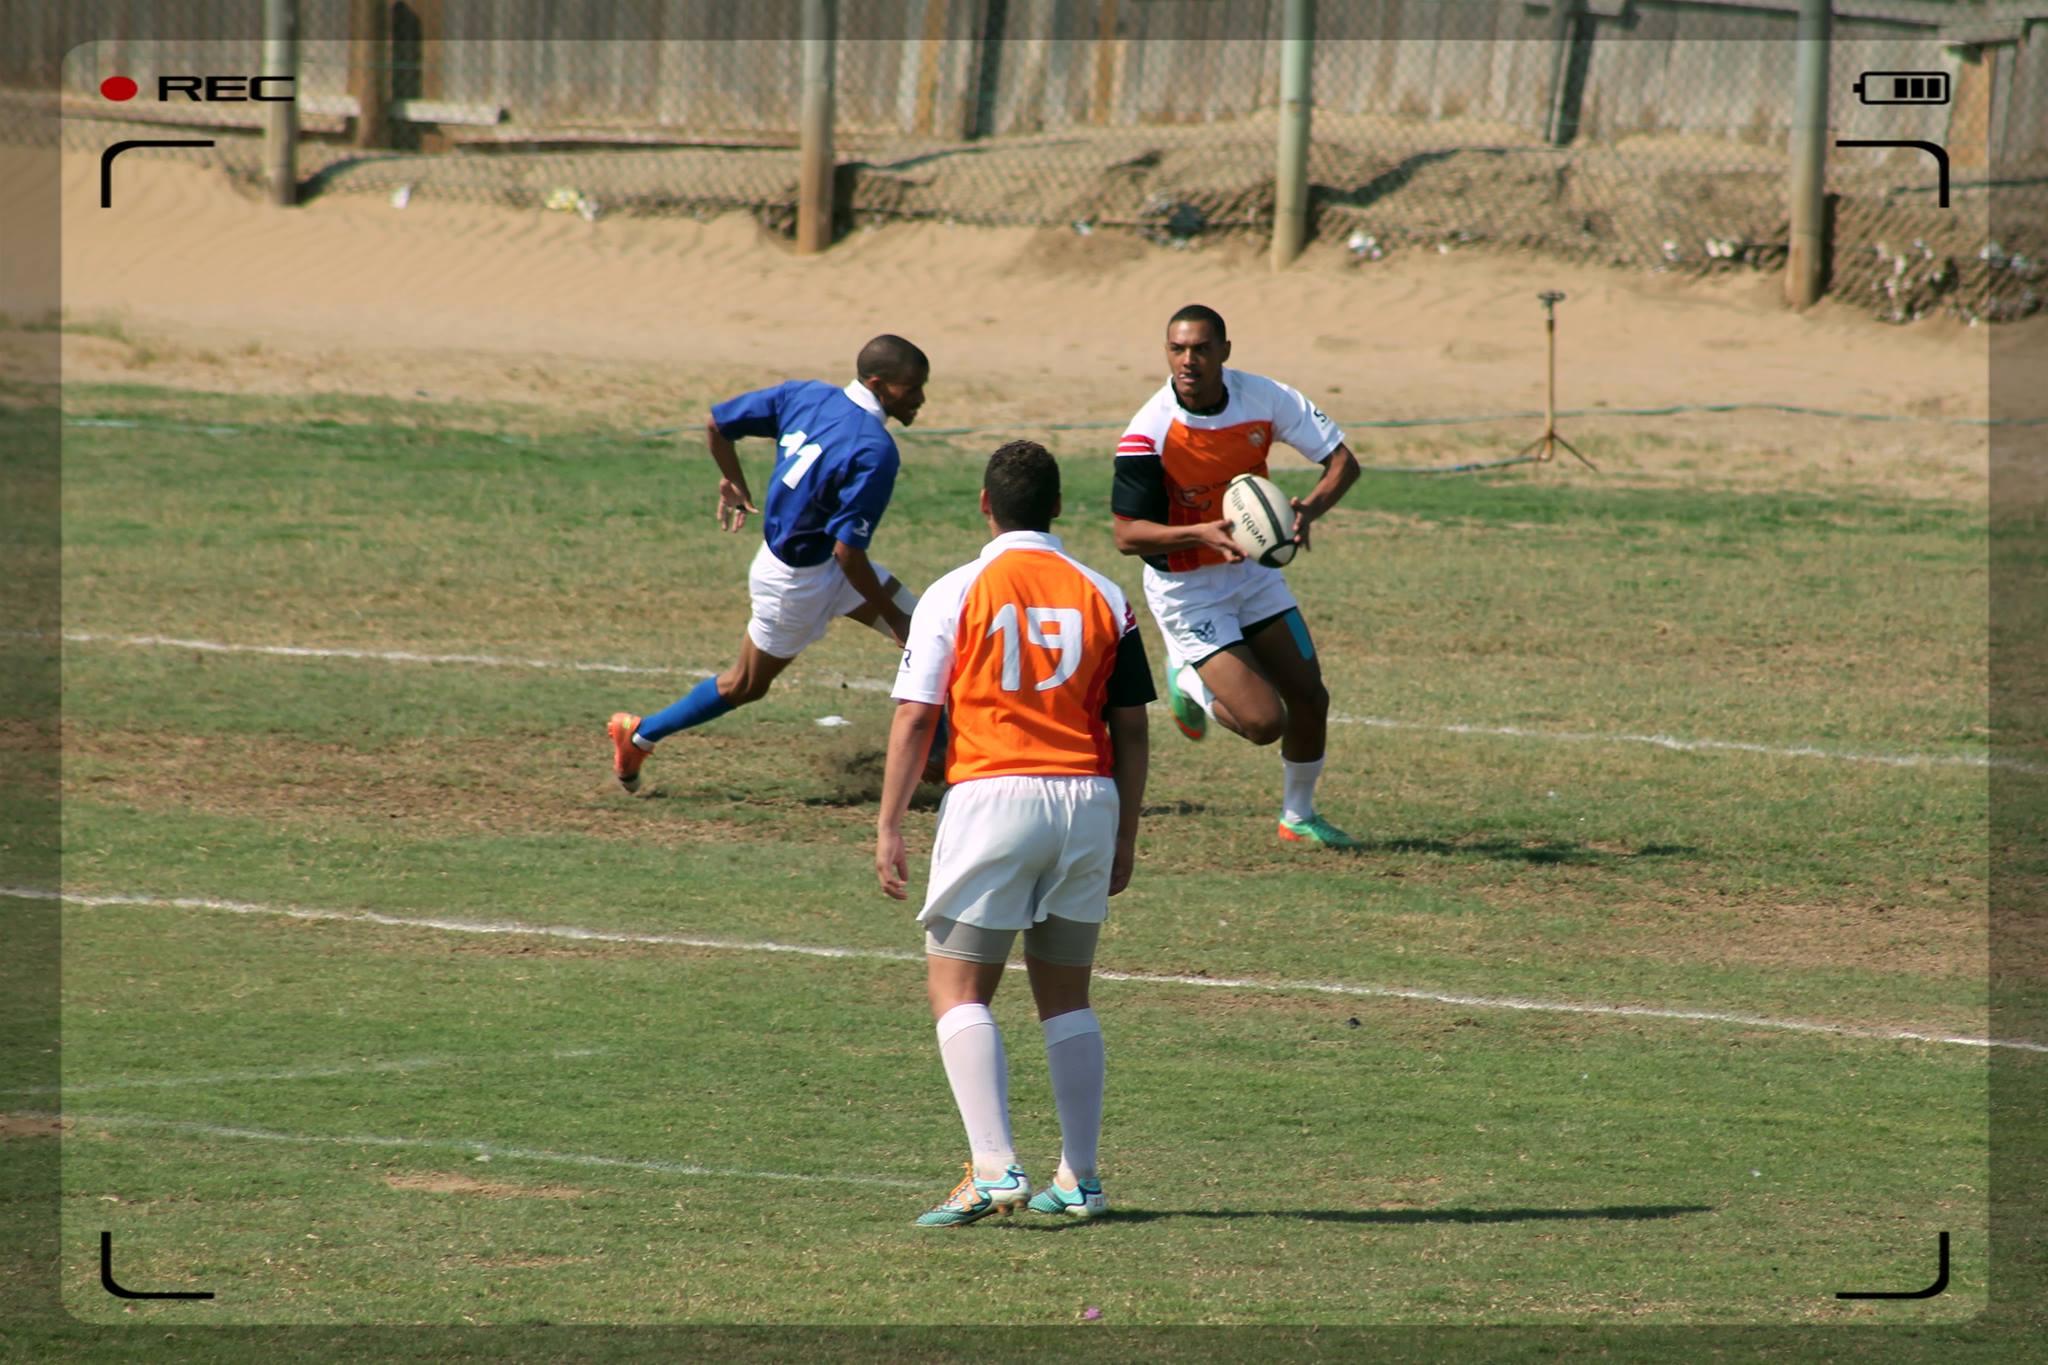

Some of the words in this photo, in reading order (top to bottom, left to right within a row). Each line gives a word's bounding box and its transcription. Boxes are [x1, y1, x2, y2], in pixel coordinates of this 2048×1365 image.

[1230, 487, 1245, 512] ellis
[1241, 512, 1267, 547] webb
[986, 602, 1084, 692] 19
